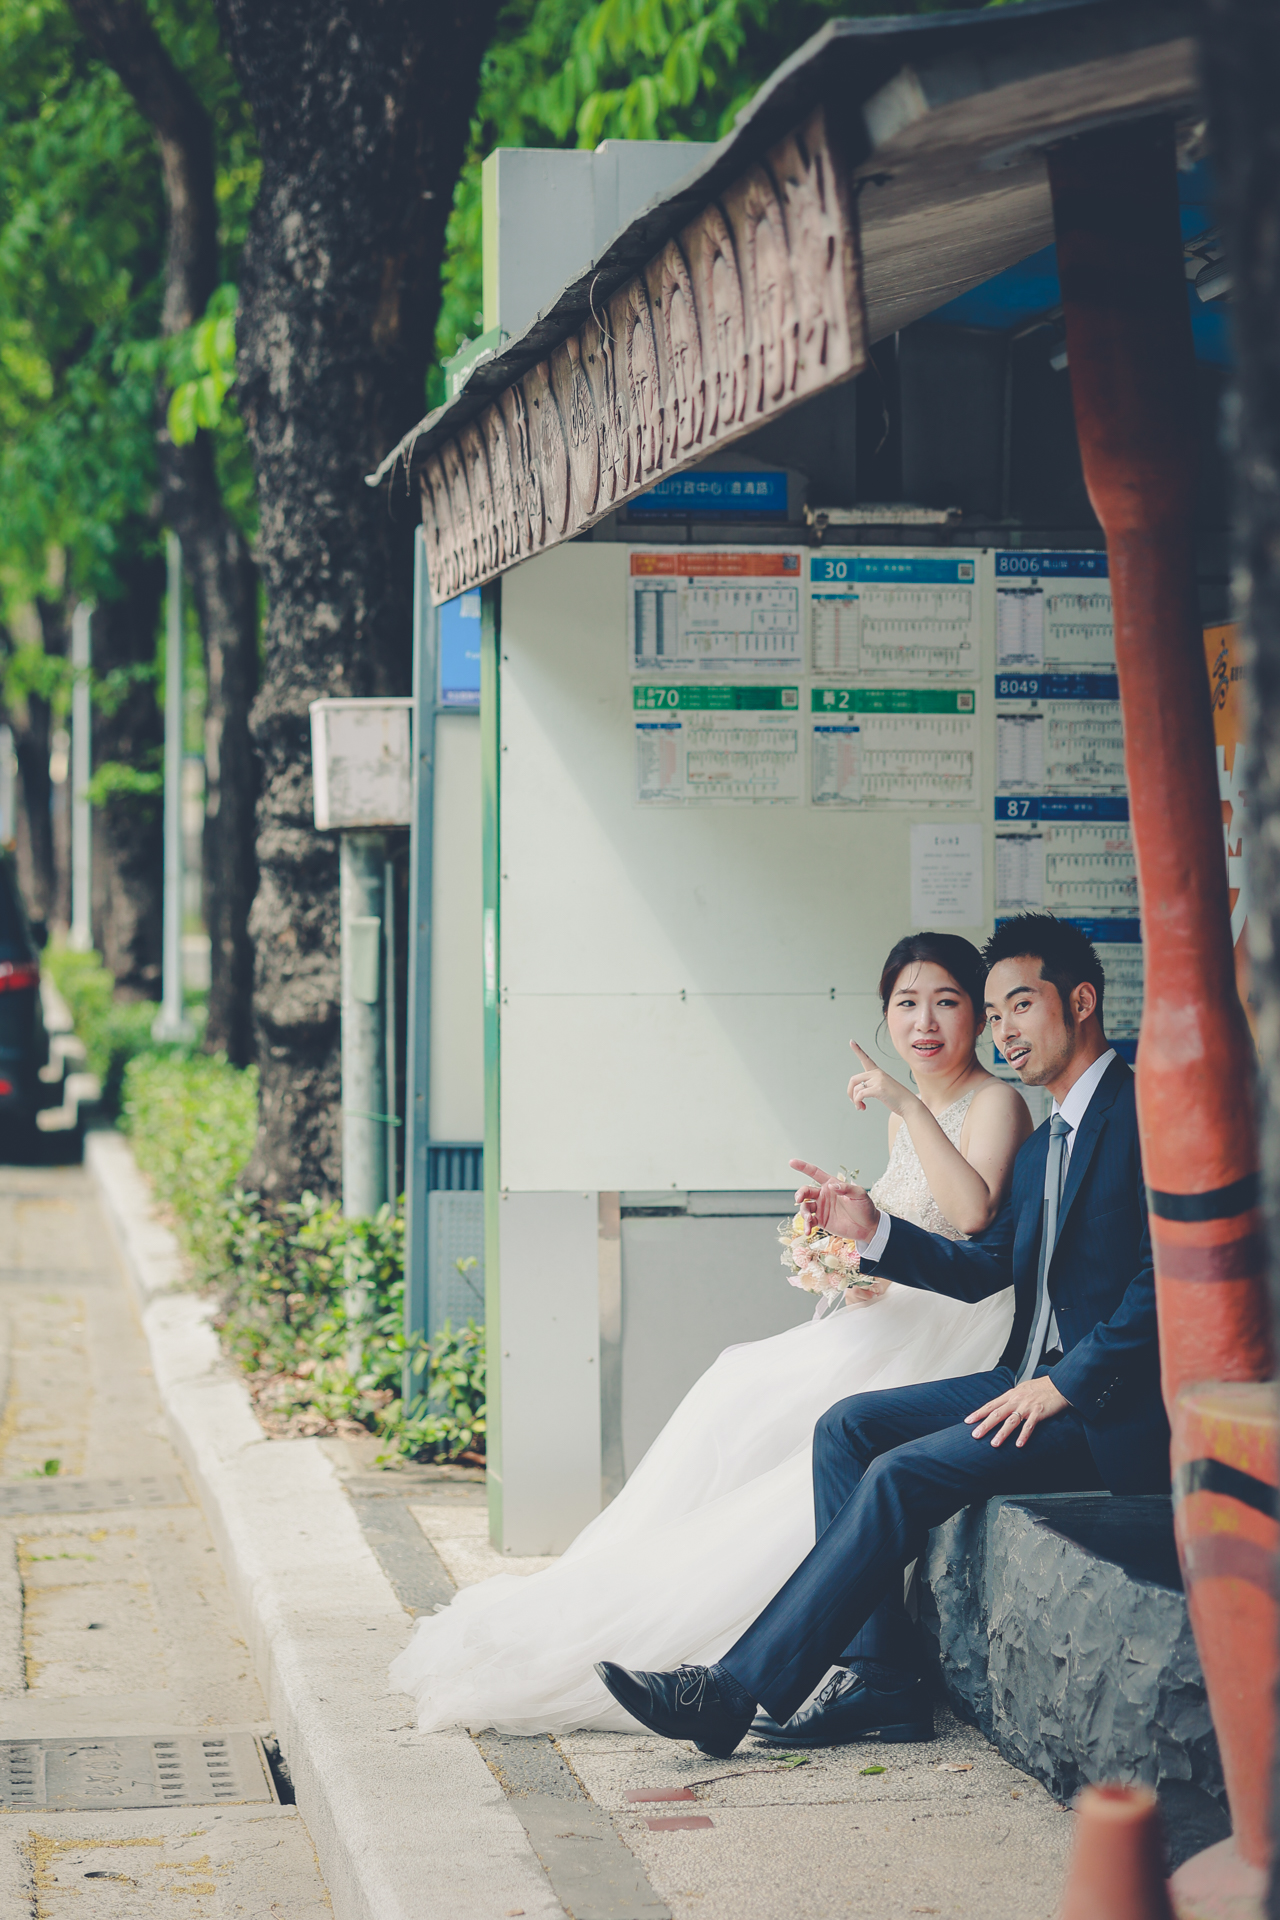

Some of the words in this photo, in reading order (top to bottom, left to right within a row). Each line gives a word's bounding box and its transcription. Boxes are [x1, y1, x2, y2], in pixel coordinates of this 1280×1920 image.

[825, 561, 847, 579] 30
[999, 557, 1039, 572] 8006
[1000, 680, 1038, 694] 8049
[655, 689, 679, 706] 70
[1007, 800, 1030, 817] 87
